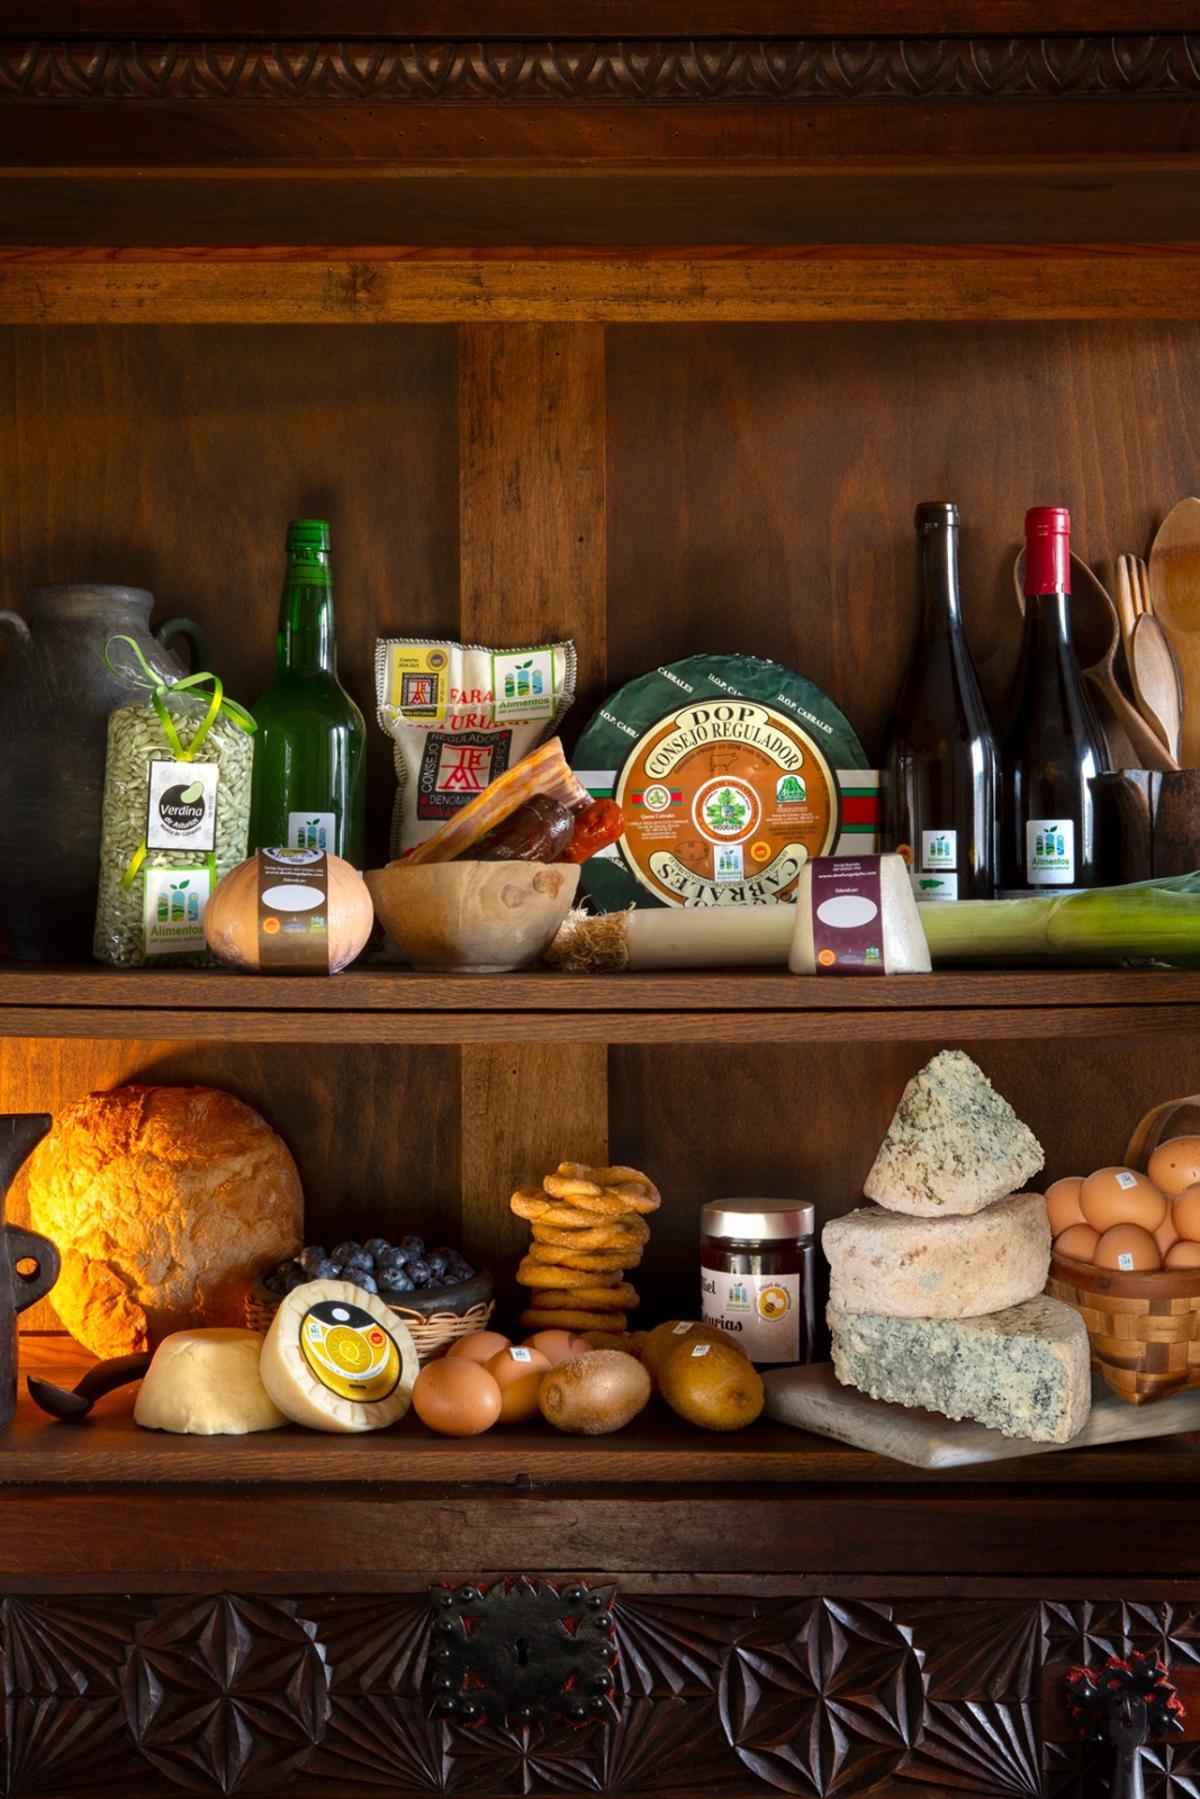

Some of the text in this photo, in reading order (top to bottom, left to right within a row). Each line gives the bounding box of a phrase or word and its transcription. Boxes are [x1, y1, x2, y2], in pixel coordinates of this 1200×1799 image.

[657, 666, 694, 693] CABRALES
[708, 672, 727, 691] D.O.P.
[499, 697, 549, 709] Alimentos
[690, 704, 755, 727] DOP
[777, 693, 834, 734] D.O.P. CABRALES
[431, 732, 500, 743] REGULADOR
[649, 725, 708, 776] CONSEJO
[711, 720, 799, 769] REGULADOR
[421, 743, 440, 793] CONSEJO
[160, 804, 203, 817] Verdina
[172, 818, 199, 829] Asturias
[1032, 857, 1069, 866] Alimentos
[657, 857, 799, 902] CABRALES
[150, 925, 205, 937] Alimentos
